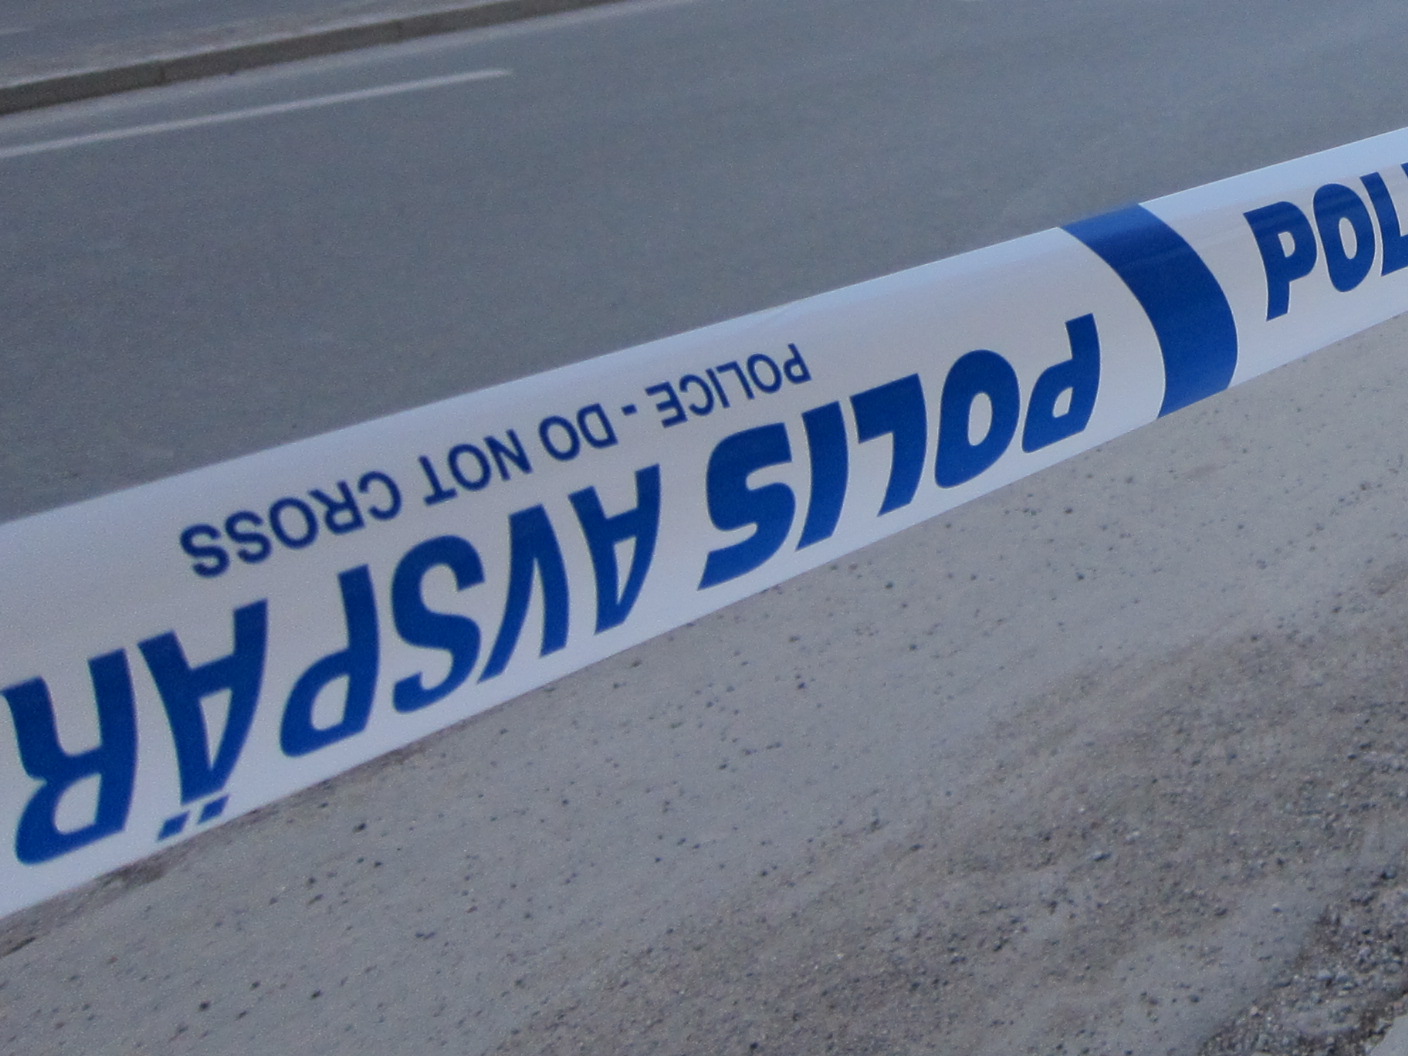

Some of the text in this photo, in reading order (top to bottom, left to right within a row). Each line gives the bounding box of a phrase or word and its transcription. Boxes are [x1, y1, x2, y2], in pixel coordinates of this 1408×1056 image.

[645, 343, 812, 428] POLICE
[418, 429, 533, 506] NOT
[539, 402, 618, 462] DO
[697, 313, 1100, 591] POLIS
[180, 471, 401, 578] CROSS
